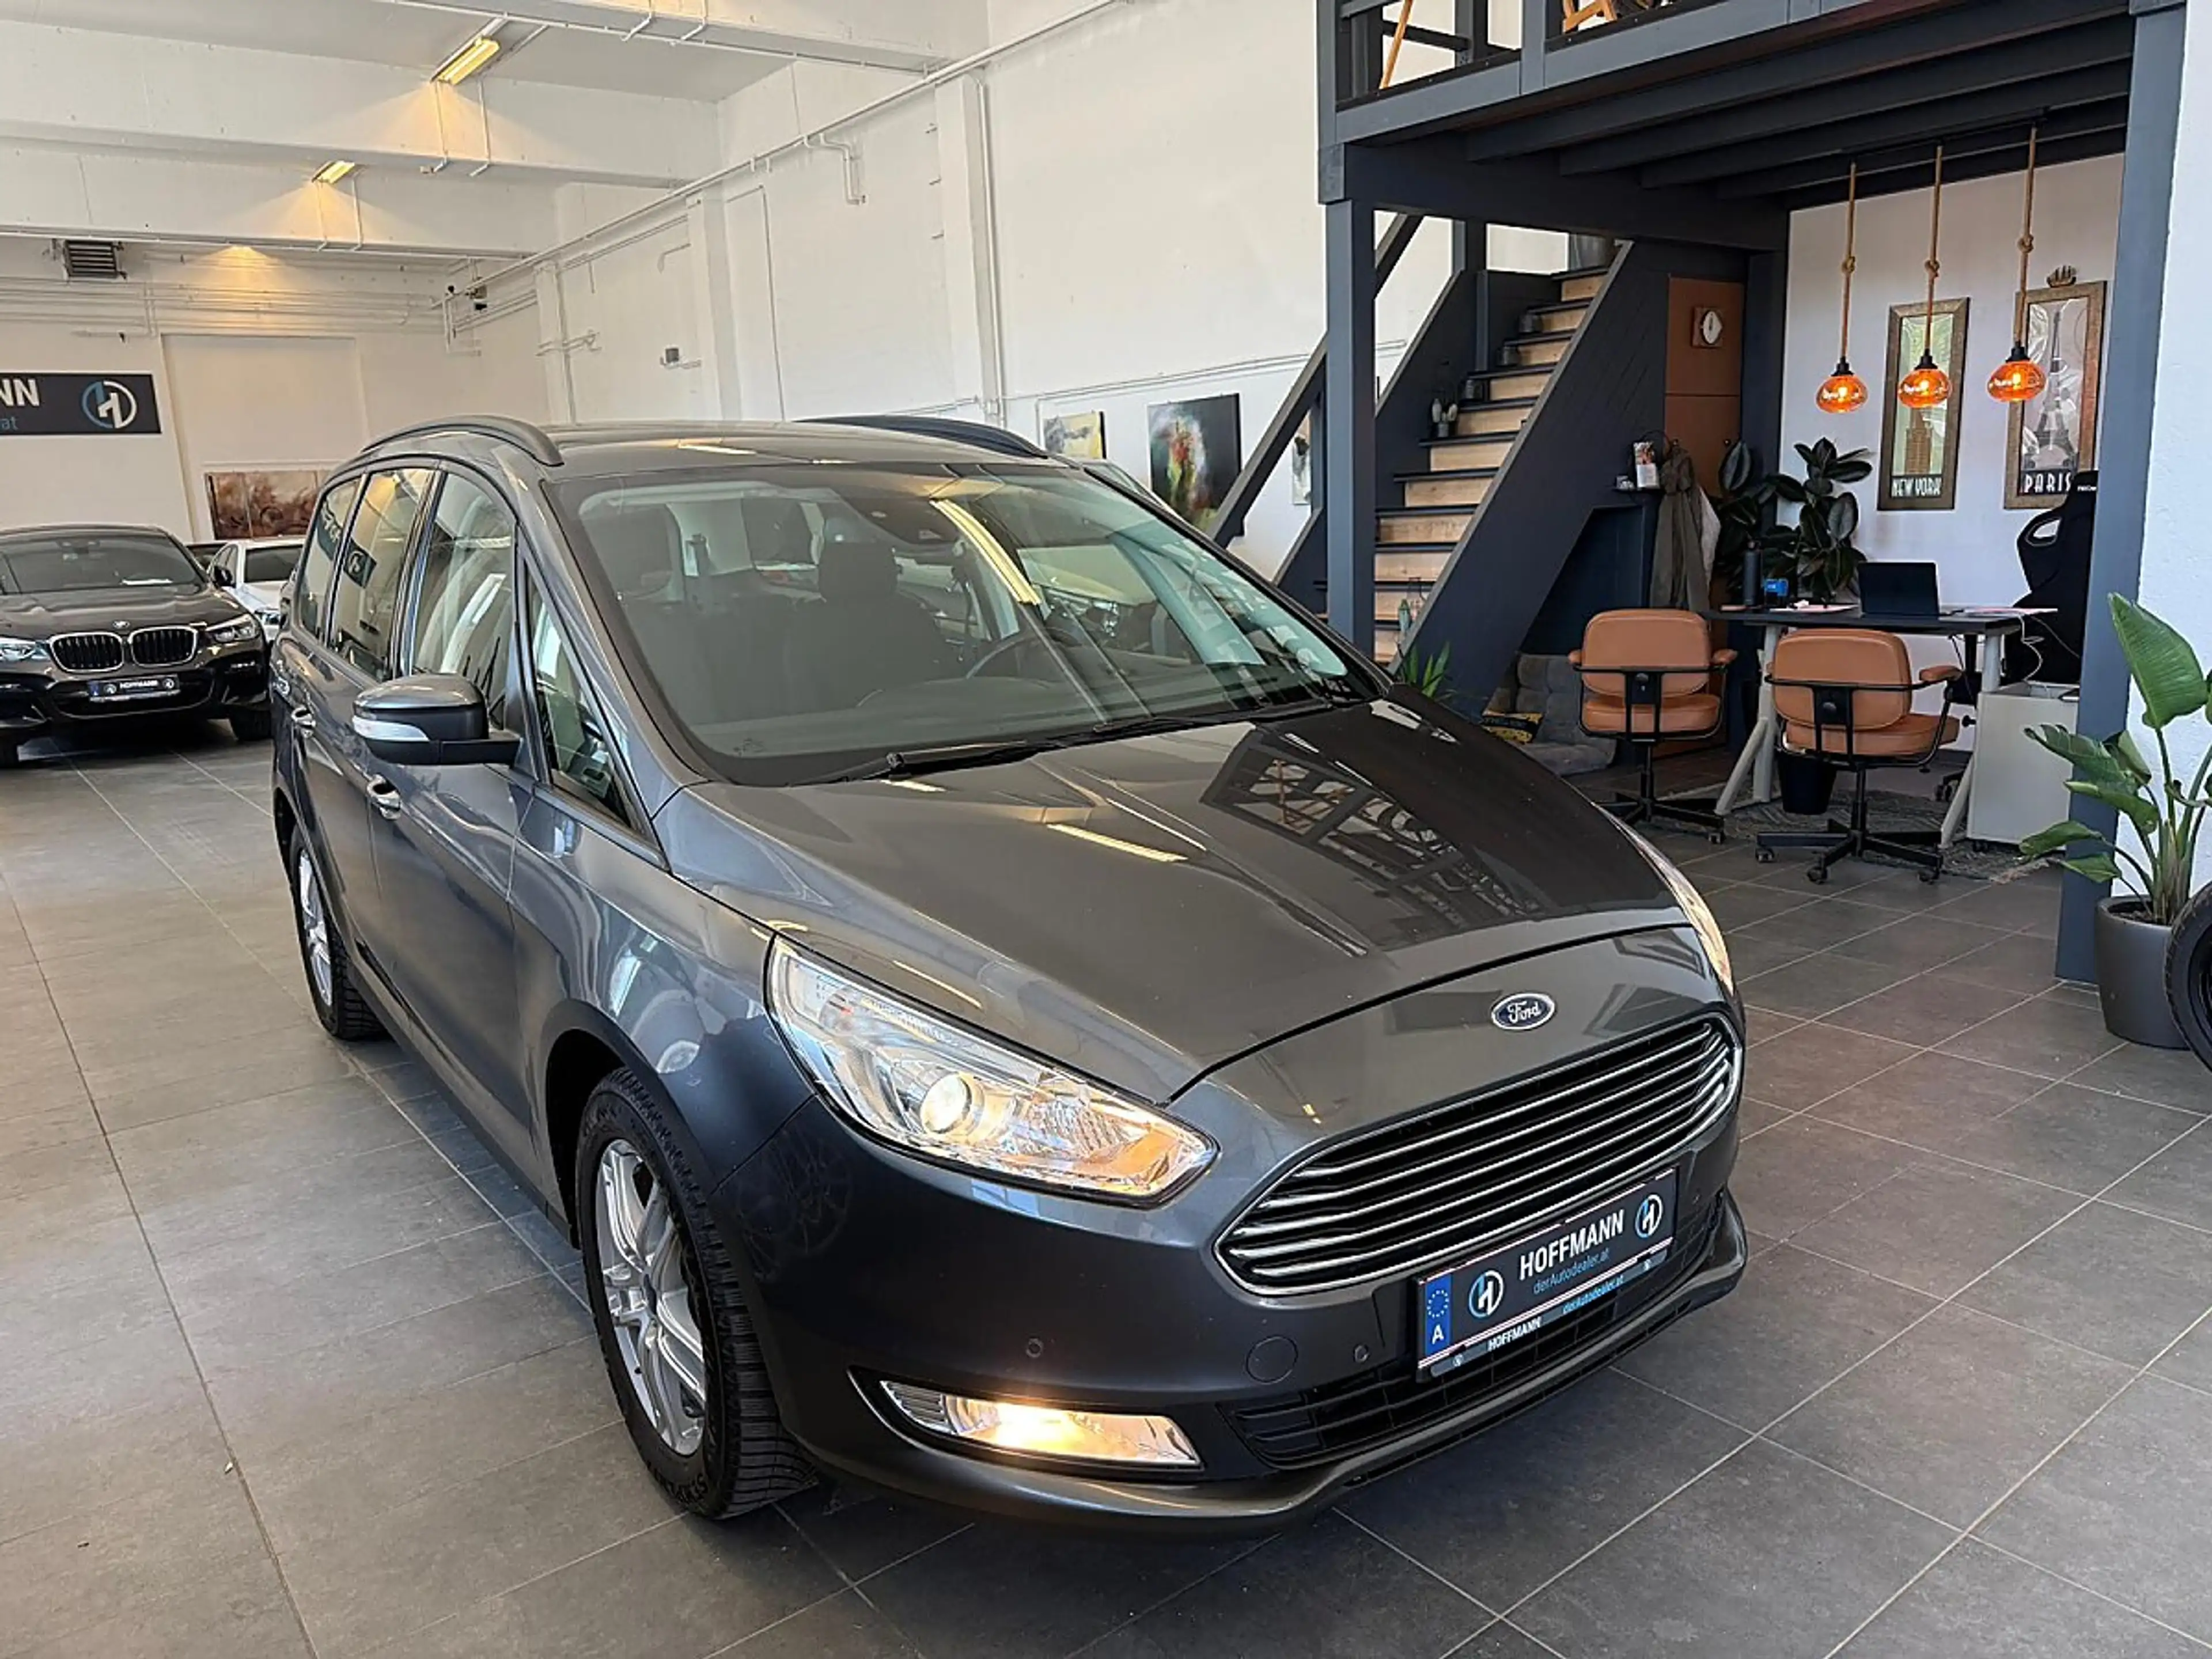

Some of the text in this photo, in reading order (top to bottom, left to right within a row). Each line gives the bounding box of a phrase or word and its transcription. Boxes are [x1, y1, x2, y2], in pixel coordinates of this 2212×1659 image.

[1891, 476, 1942, 497] NEW YORK
[2023, 471, 2072, 493] PARIS
[1507, 1000, 1542, 1024] Ford
[1518, 1209, 1625, 1281] HOFFMANN
[1533, 1247, 1610, 1295] derAutodealer.at
[1431, 1323, 1445, 1345] A
[1487, 1316, 1543, 1352] HOFFMANN
